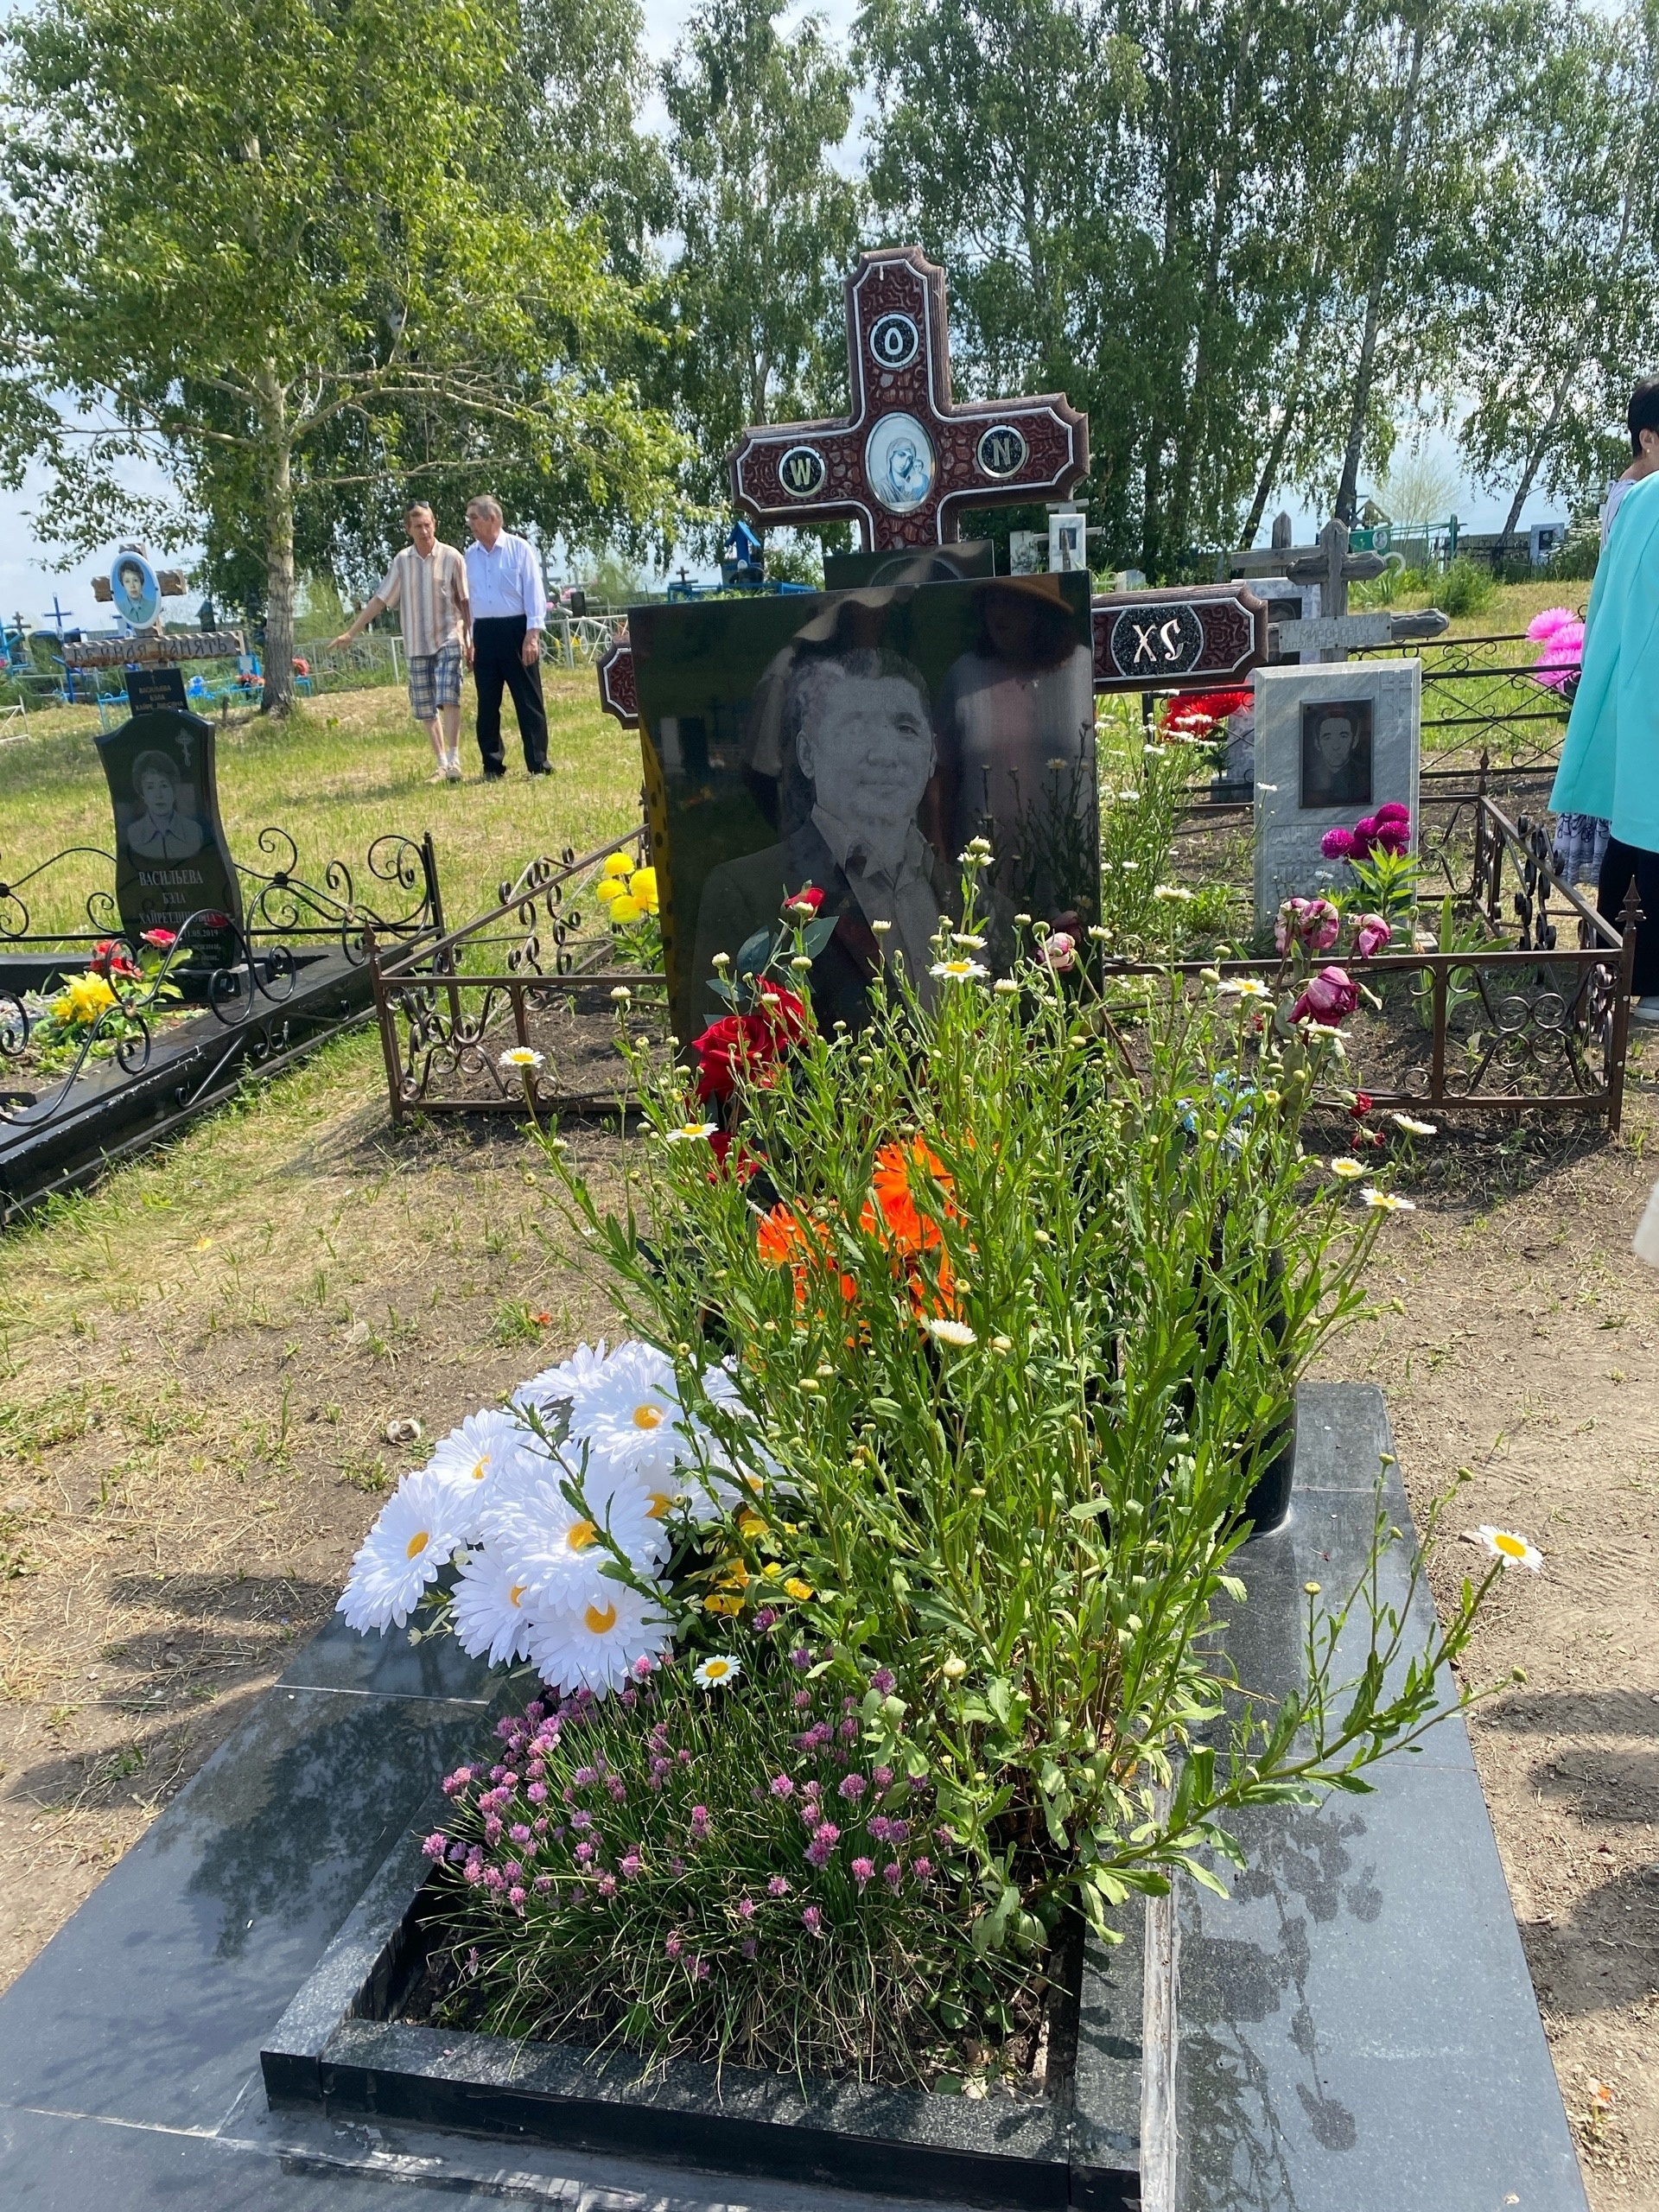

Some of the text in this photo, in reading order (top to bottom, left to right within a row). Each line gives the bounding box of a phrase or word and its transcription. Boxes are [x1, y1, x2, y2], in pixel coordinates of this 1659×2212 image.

[73, 638, 227, 663] ВЕЧНАЯ ПАМЯТЬ
[138, 869, 203, 886] ВАСИЛЬЕВА
[162, 893, 186, 904] БЭЛА
